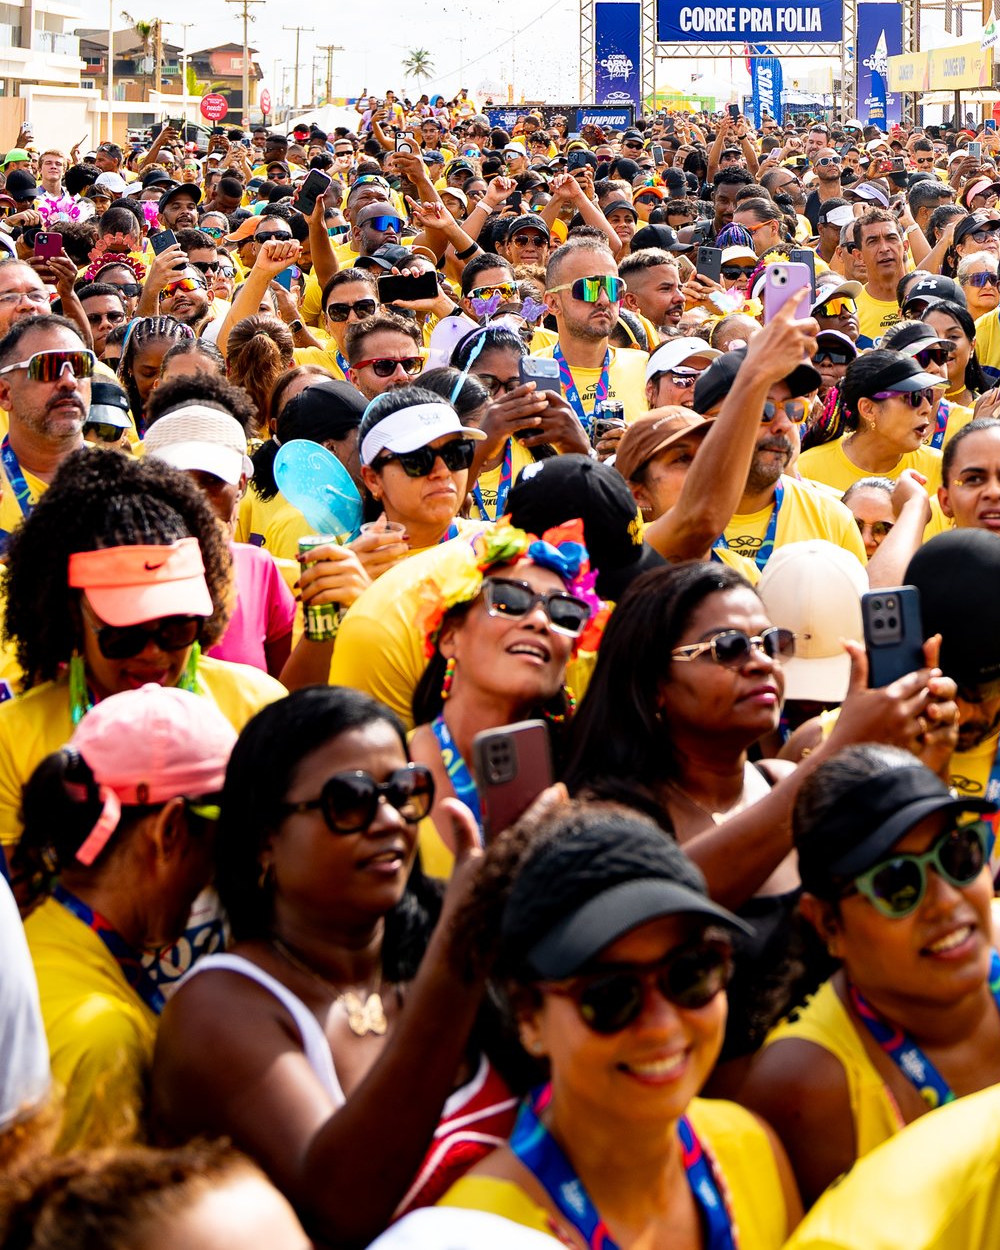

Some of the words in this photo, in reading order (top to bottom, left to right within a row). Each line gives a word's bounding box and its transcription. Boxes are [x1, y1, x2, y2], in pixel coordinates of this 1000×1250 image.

[679, 7, 736, 32] CORRE
[739, 7, 773, 32] PRA
[776, 7, 822, 32] FOLIA
[581, 115, 626, 125] OLYMPIKUS
